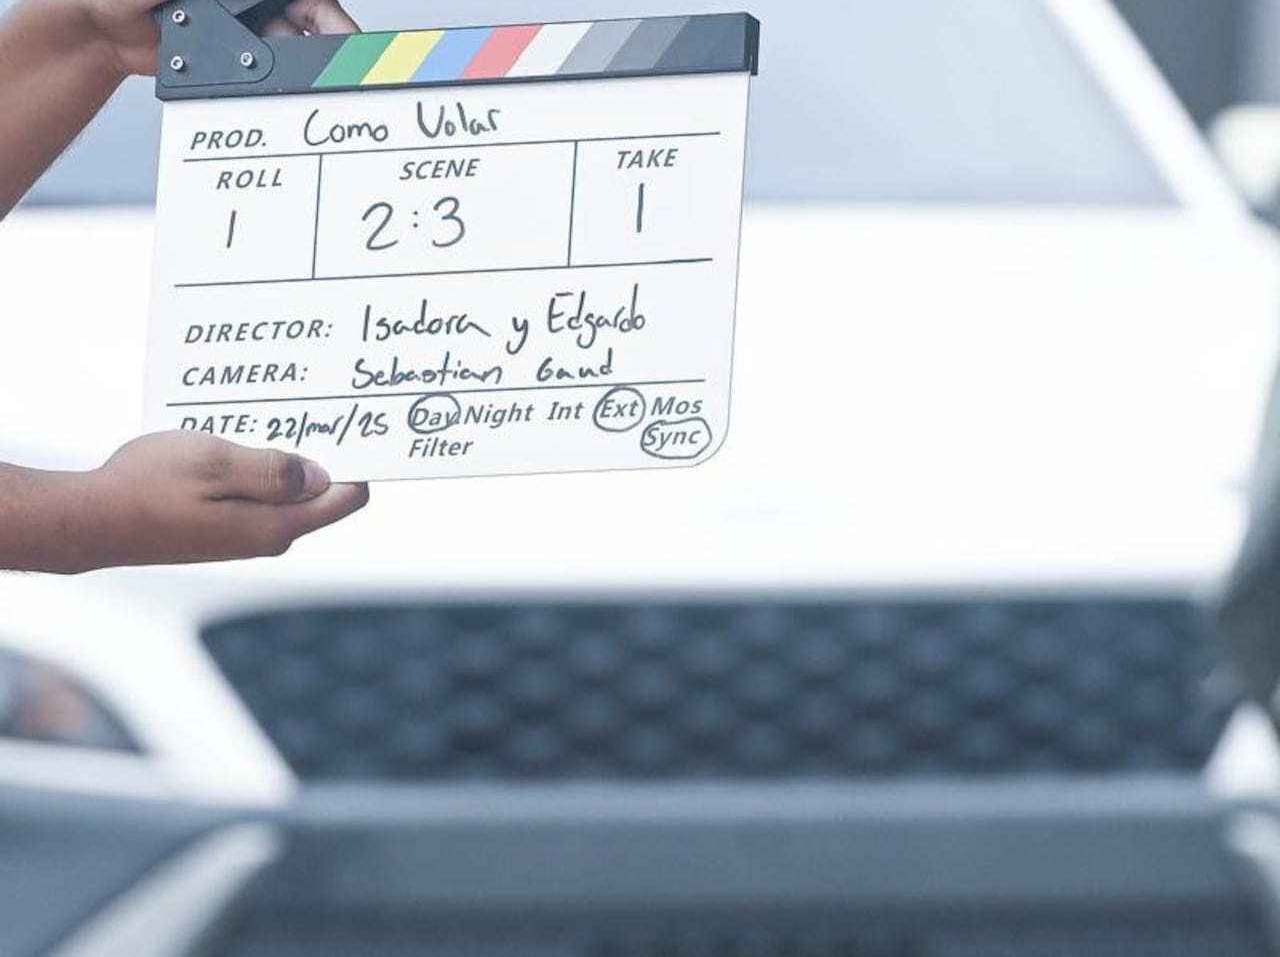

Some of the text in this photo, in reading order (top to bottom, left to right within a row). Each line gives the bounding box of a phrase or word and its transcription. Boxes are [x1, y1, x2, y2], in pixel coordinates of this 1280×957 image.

[304, 101, 502, 146] Como Volar
[190, 129, 268, 151] PROD.
[399, 158, 481, 181] SCENE
[616, 148, 679, 169] TAKE
[216, 169, 284, 190] ROLL
[361, 196, 467, 251] 2:3
[361, 283, 646, 355] Isadora y Edgardo
[184, 320, 333, 345] DIRECTOR:
[181, 362, 309, 387] CAMERA:
[352, 351, 503, 389] Sebastian
[463, 401, 535, 427] Night
[546, 399, 584, 422] Int
[600, 397, 639, 419] Ext
[650, 394, 704, 417] Mos
[180, 412, 259, 435] DATE:
[408, 437, 474, 460] Filter
[640, 425, 702, 450] Sync
